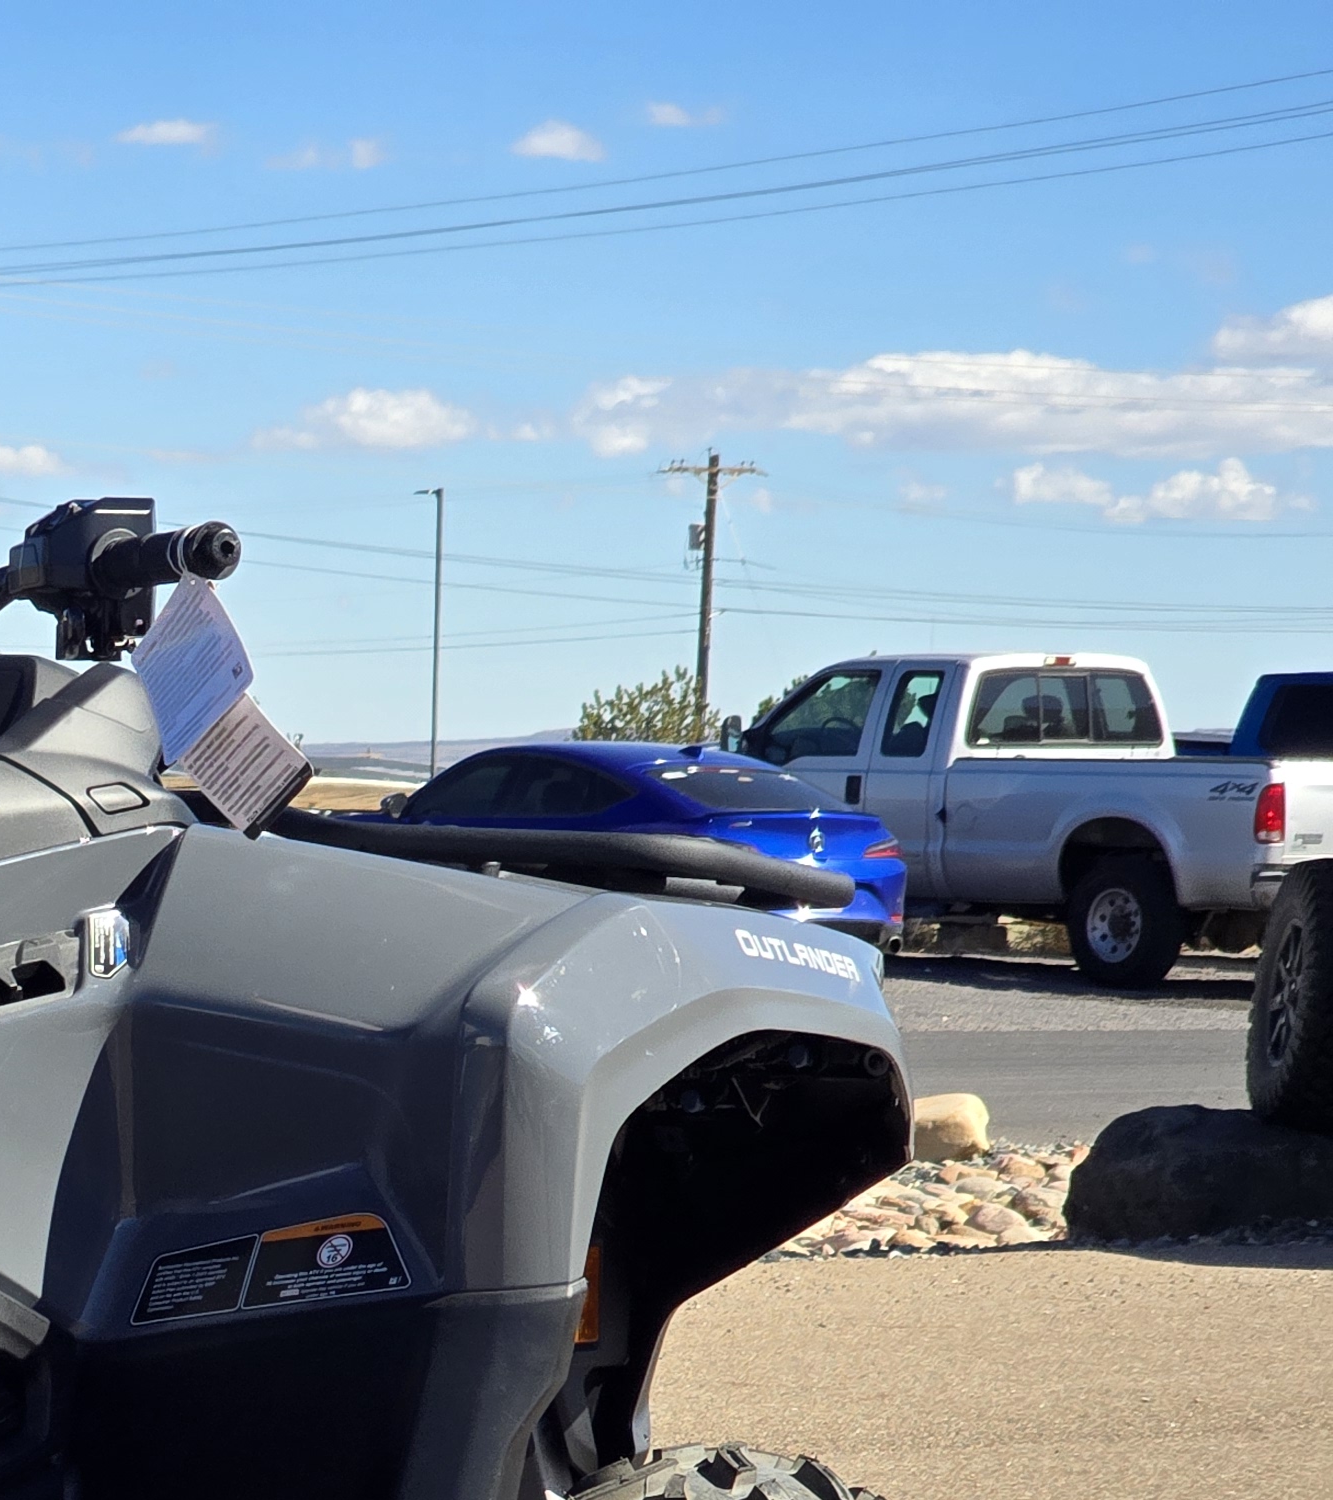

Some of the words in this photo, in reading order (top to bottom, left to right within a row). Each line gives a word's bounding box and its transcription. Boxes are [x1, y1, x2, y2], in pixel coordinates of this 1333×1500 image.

[1209, 780, 1259, 796] 4x4
[734, 929, 861, 982] OUTLANDER
[326, 1253, 338, 1264] 16
